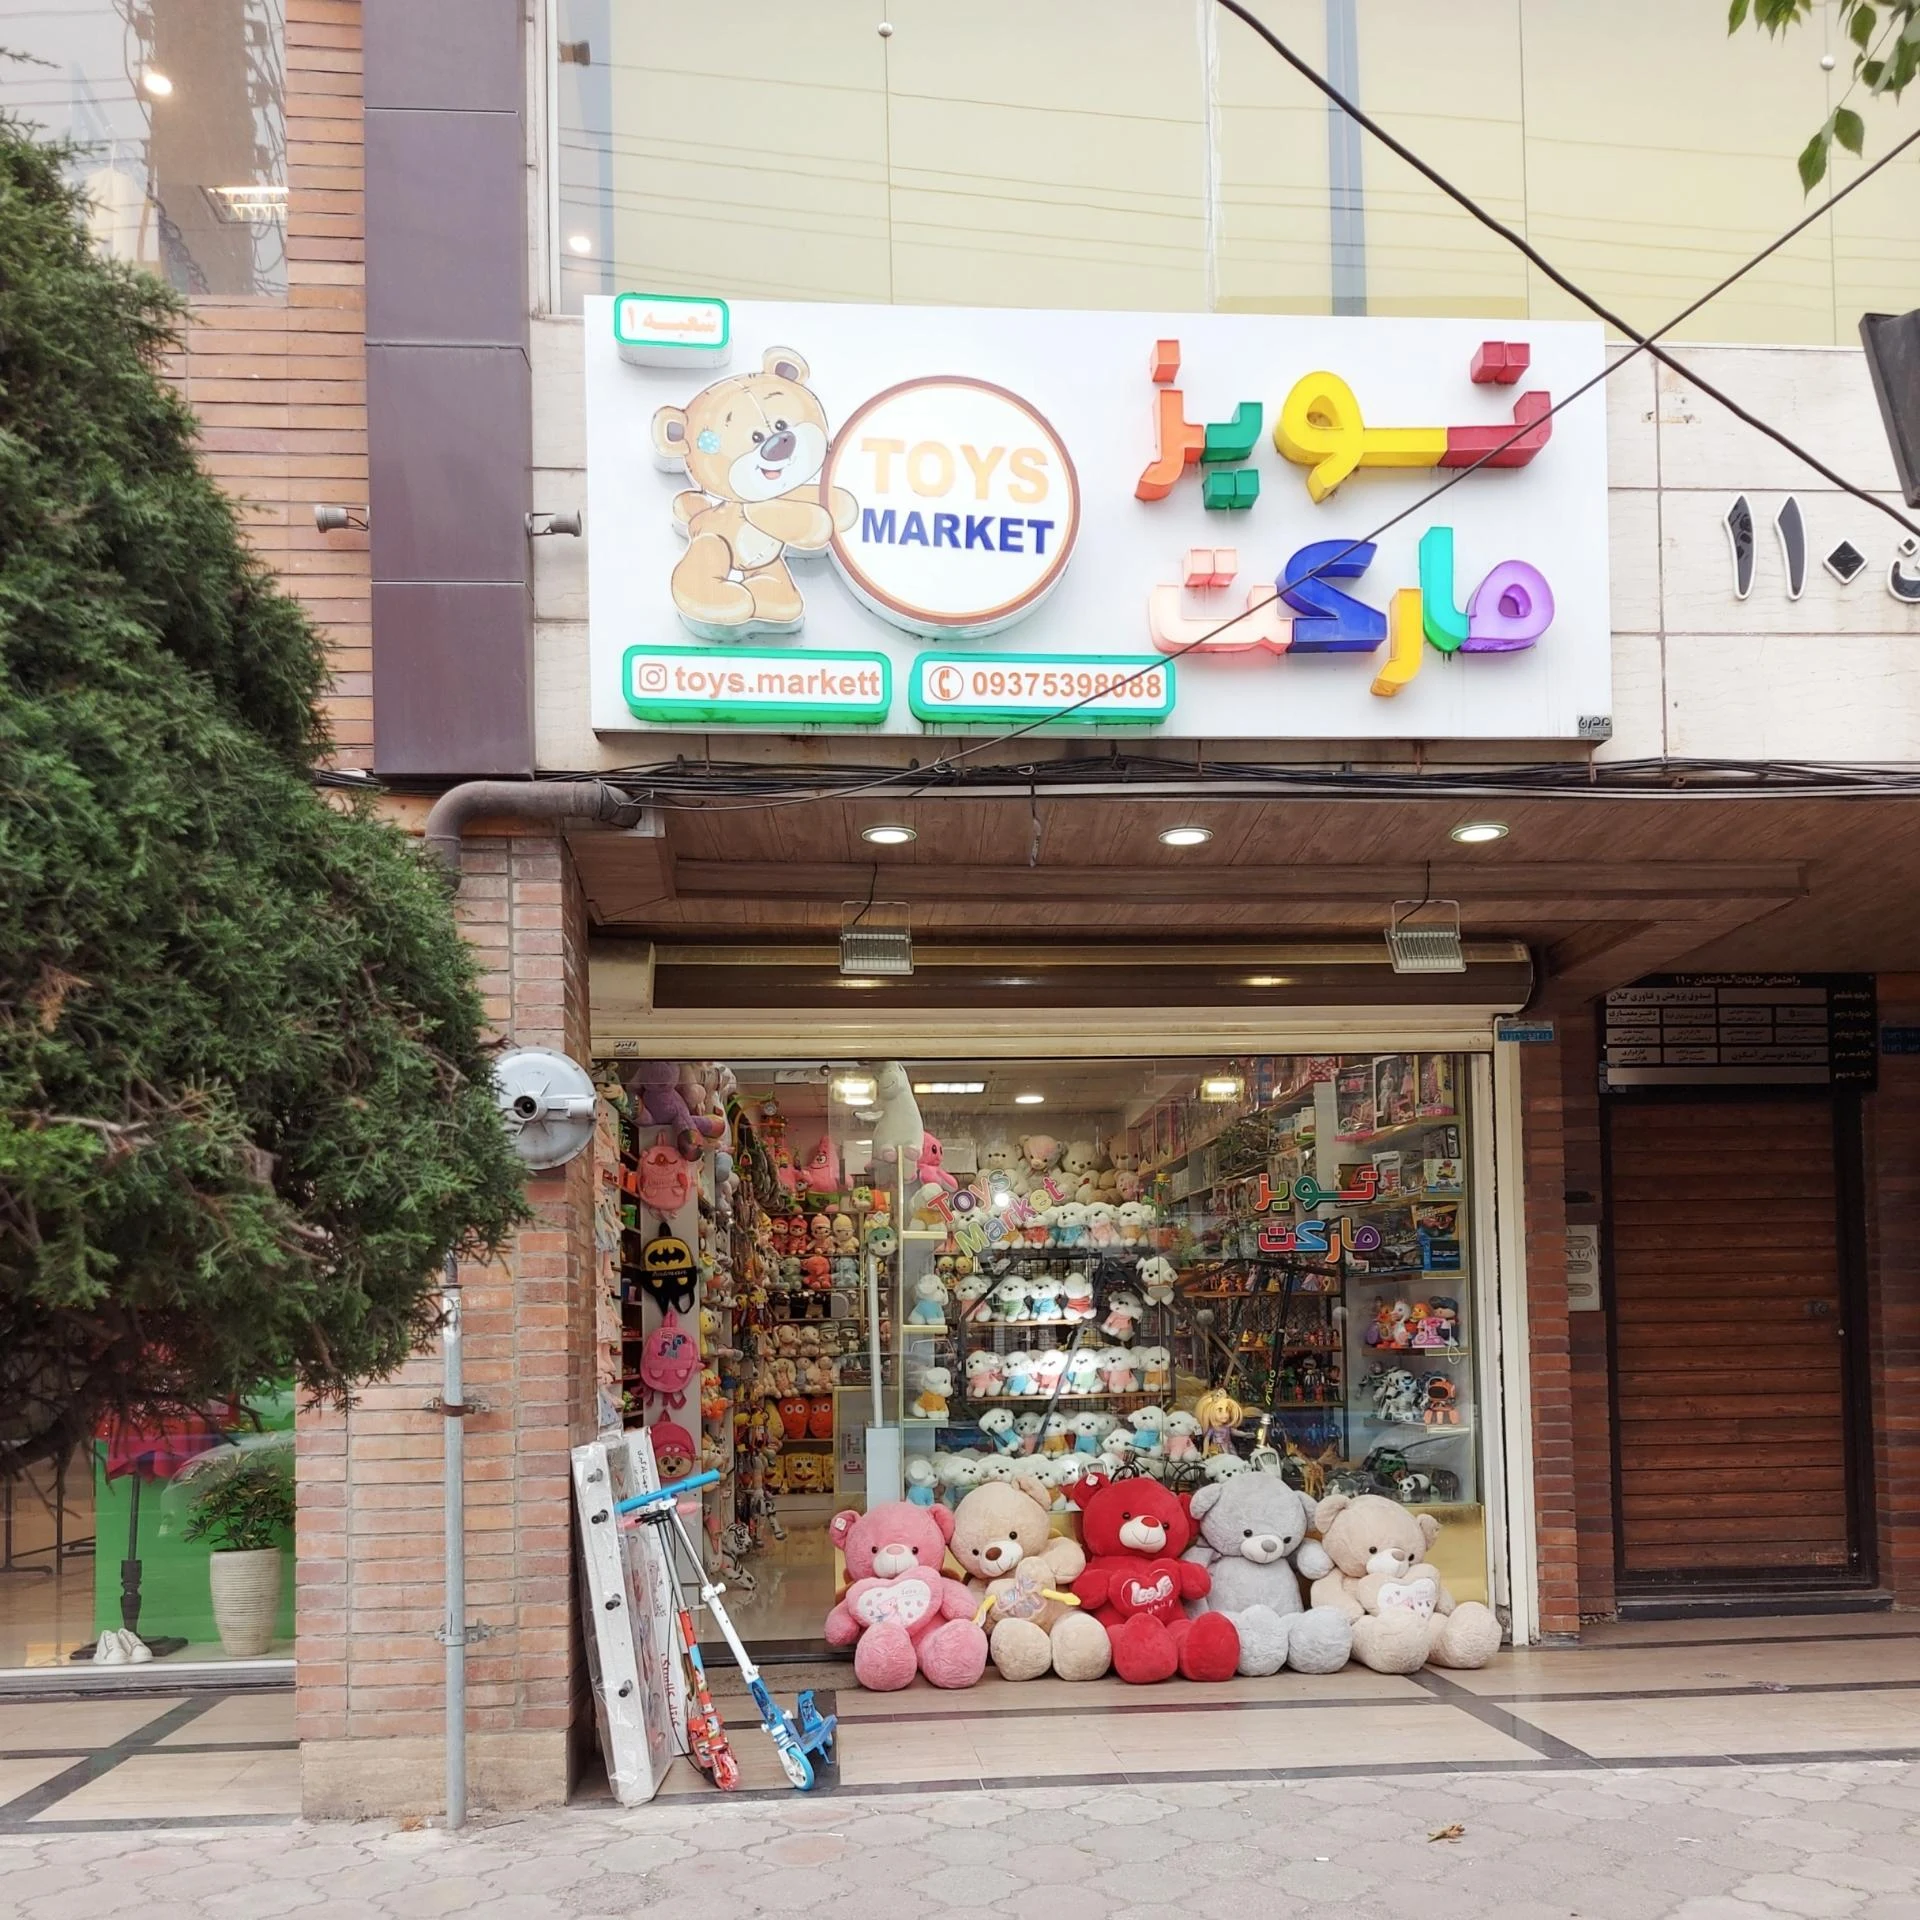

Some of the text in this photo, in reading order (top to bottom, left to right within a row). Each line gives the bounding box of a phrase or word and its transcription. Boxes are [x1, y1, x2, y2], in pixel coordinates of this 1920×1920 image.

[642, 309, 717, 338] شعبه
[1134, 339, 1552, 504] تویز
[861, 437, 1049, 504] TOYS
[862, 508, 1055, 555] MARKET
[1148, 526, 1555, 697] مارکت
[674, 665, 881, 699] toys.markett
[972, 671, 1162, 699] 09375398088
[927, 1169, 1011, 1224] Toys
[1254, 1171, 1379, 1211] تویز
[954, 1176, 1066, 1258] Market
[1258, 1217, 1381, 1264] مارکت
